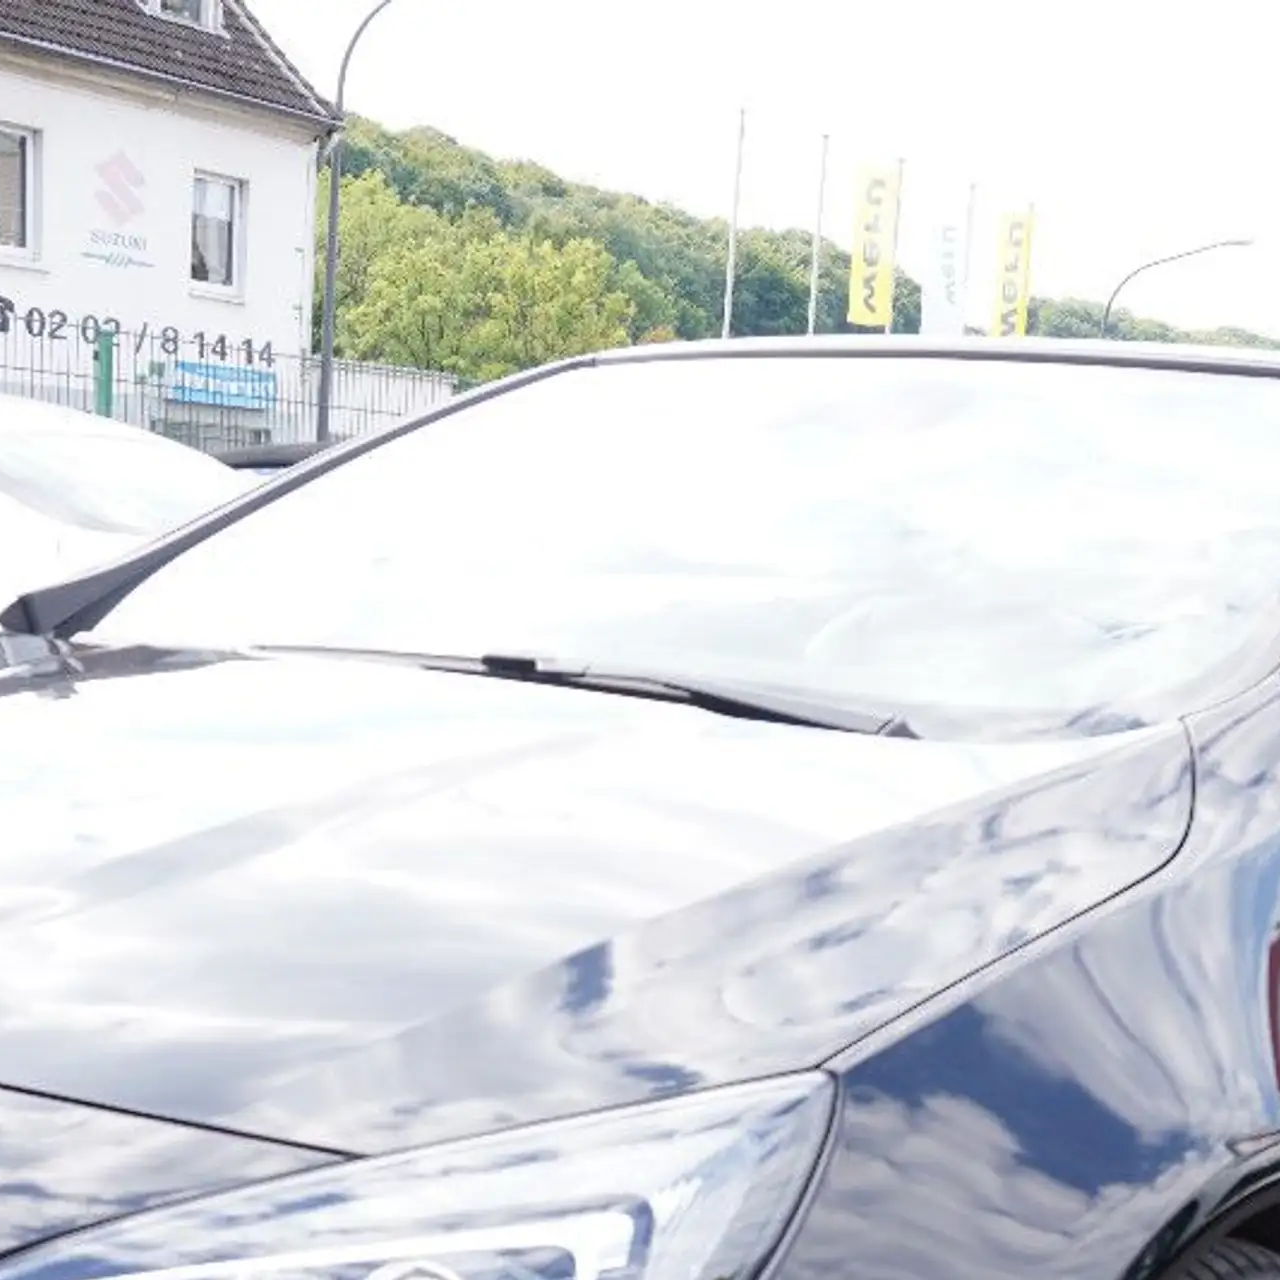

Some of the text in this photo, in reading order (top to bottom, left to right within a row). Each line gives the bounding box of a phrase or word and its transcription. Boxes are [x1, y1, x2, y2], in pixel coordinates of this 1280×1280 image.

[89, 228, 148, 250] SUZUKI
[25, 307, 67, 339] 02
[160, 326, 180, 355] 8
[194, 331, 229, 361] 14
[241, 338, 277, 368] 14
